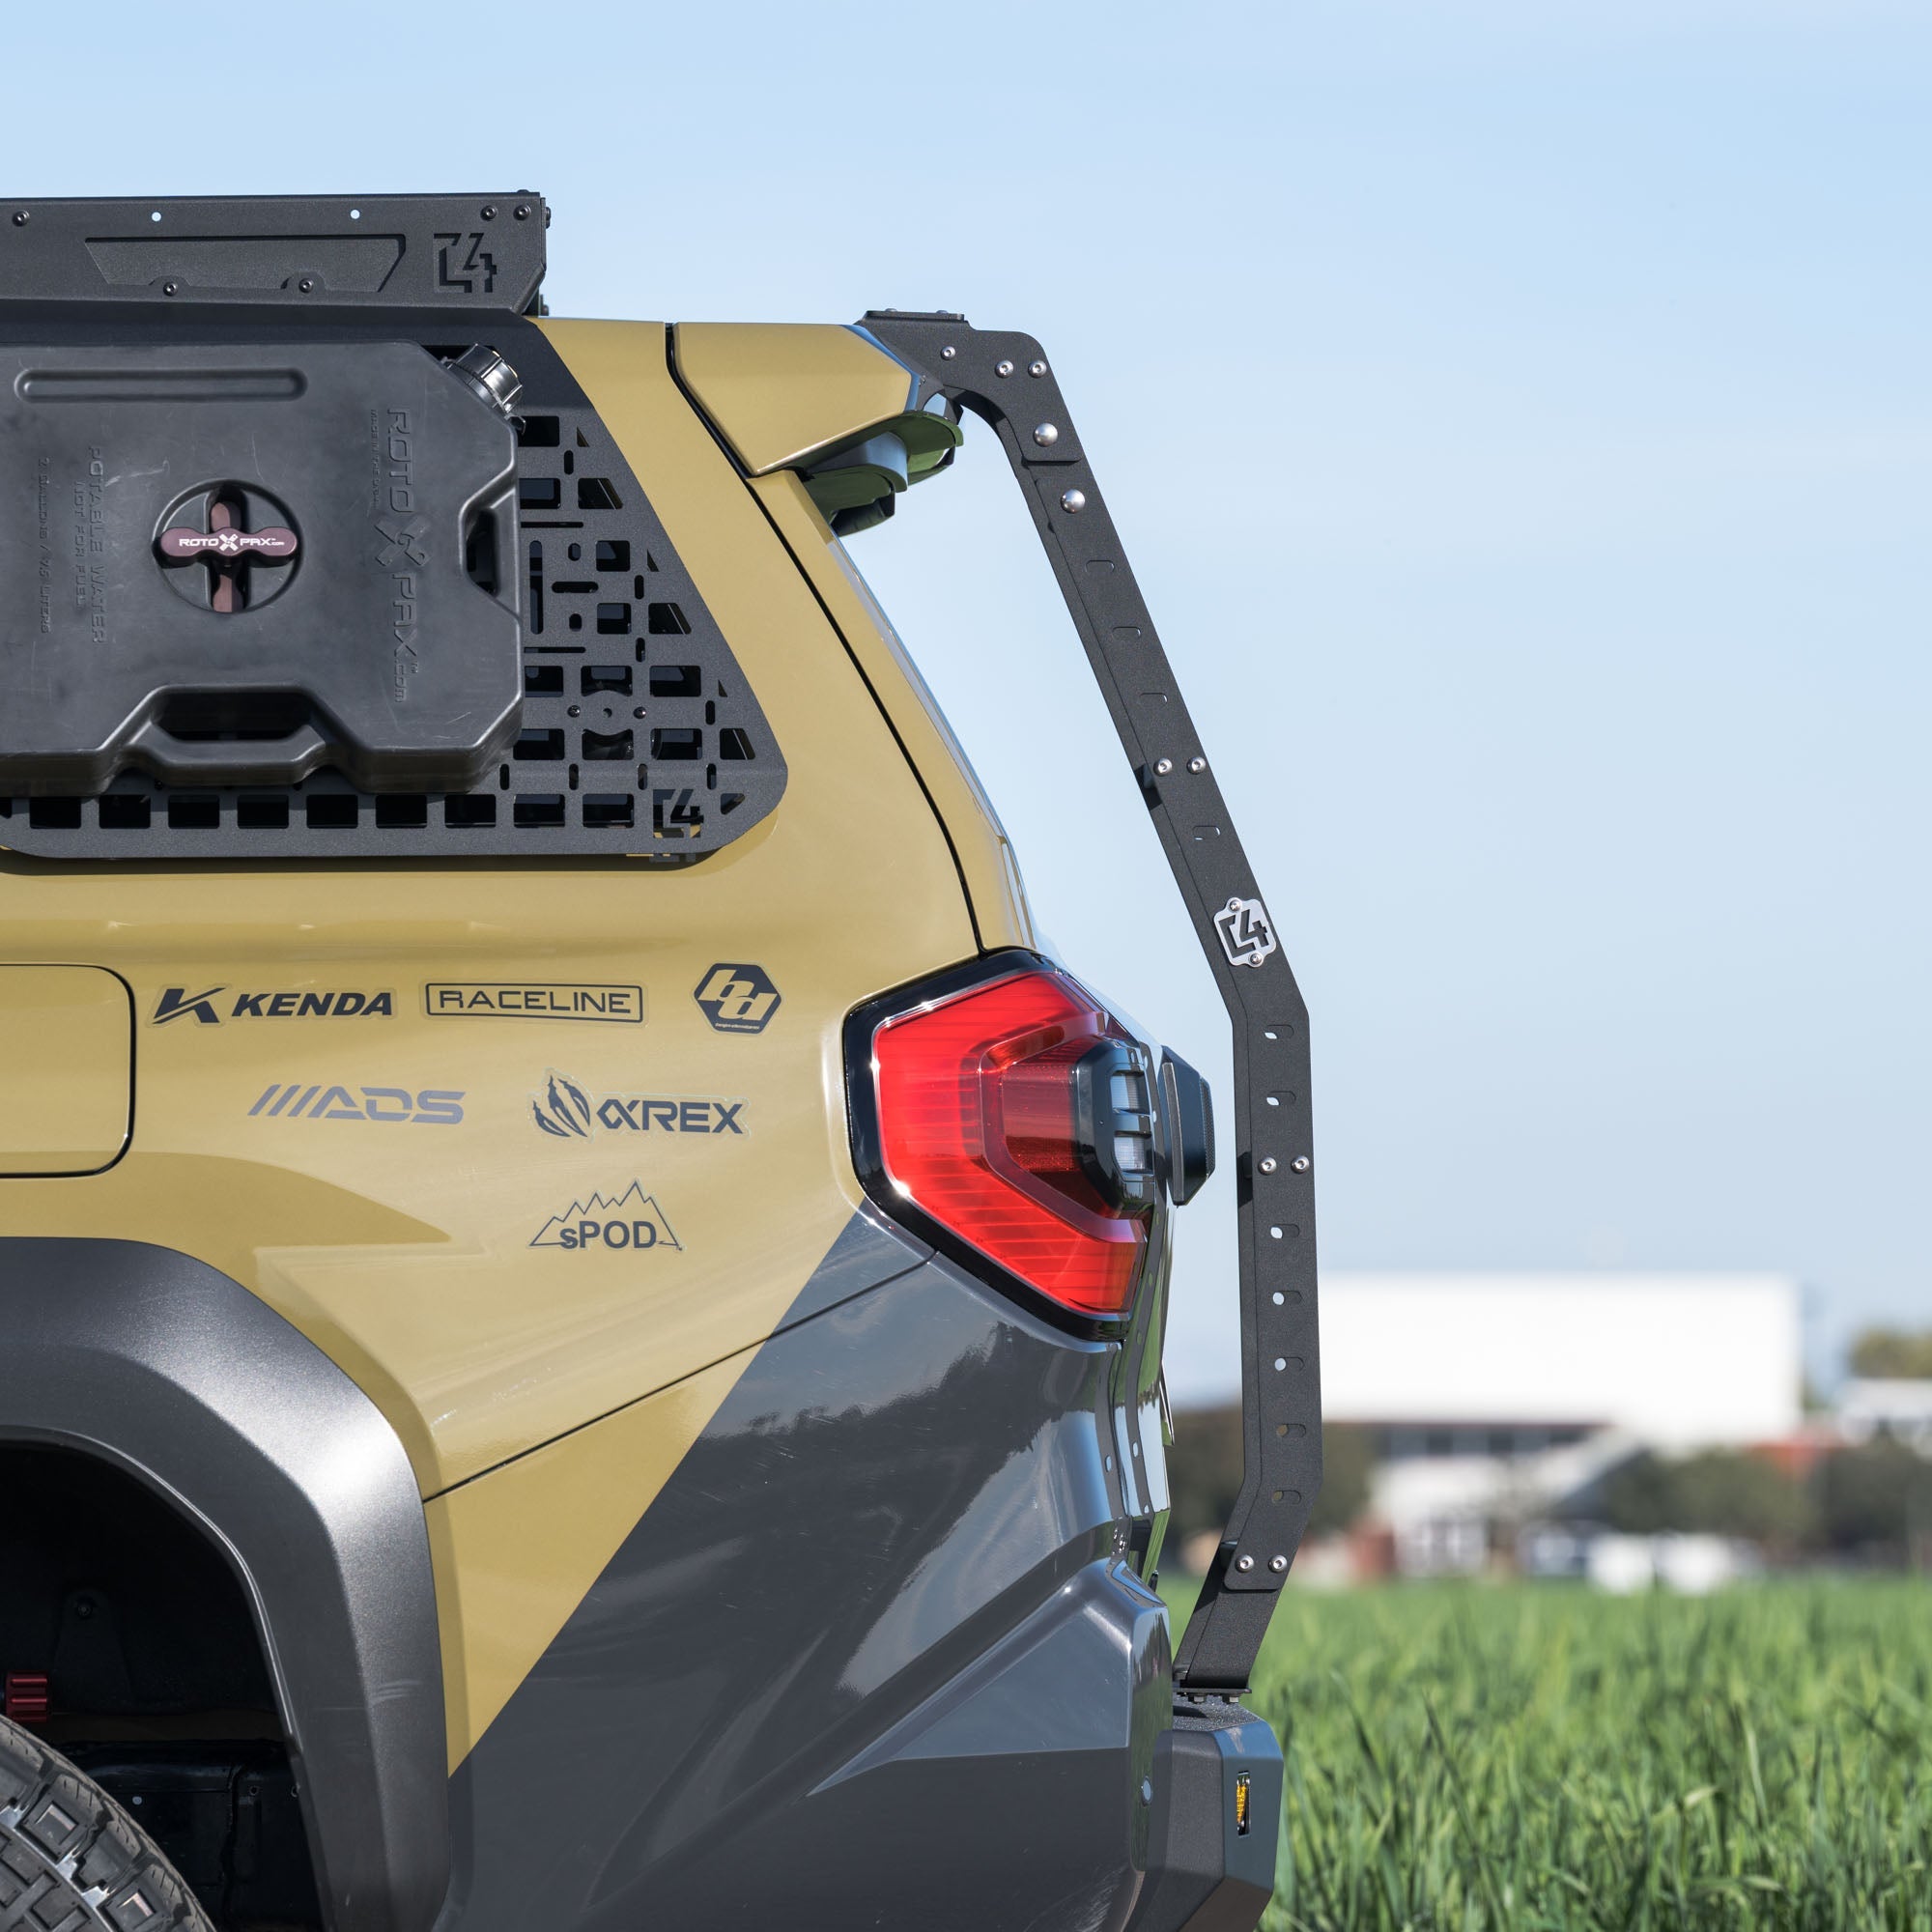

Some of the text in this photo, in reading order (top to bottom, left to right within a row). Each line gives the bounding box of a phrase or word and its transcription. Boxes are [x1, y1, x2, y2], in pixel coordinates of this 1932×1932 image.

[74, 481, 86, 607] NOT FOR FUEL
[89, 446, 108, 642] POTABLE WATER
[231, 992, 393, 1017] KENDA
[439, 990, 632, 1014] RACELINE
[558, 1220, 658, 1250] sPOD
